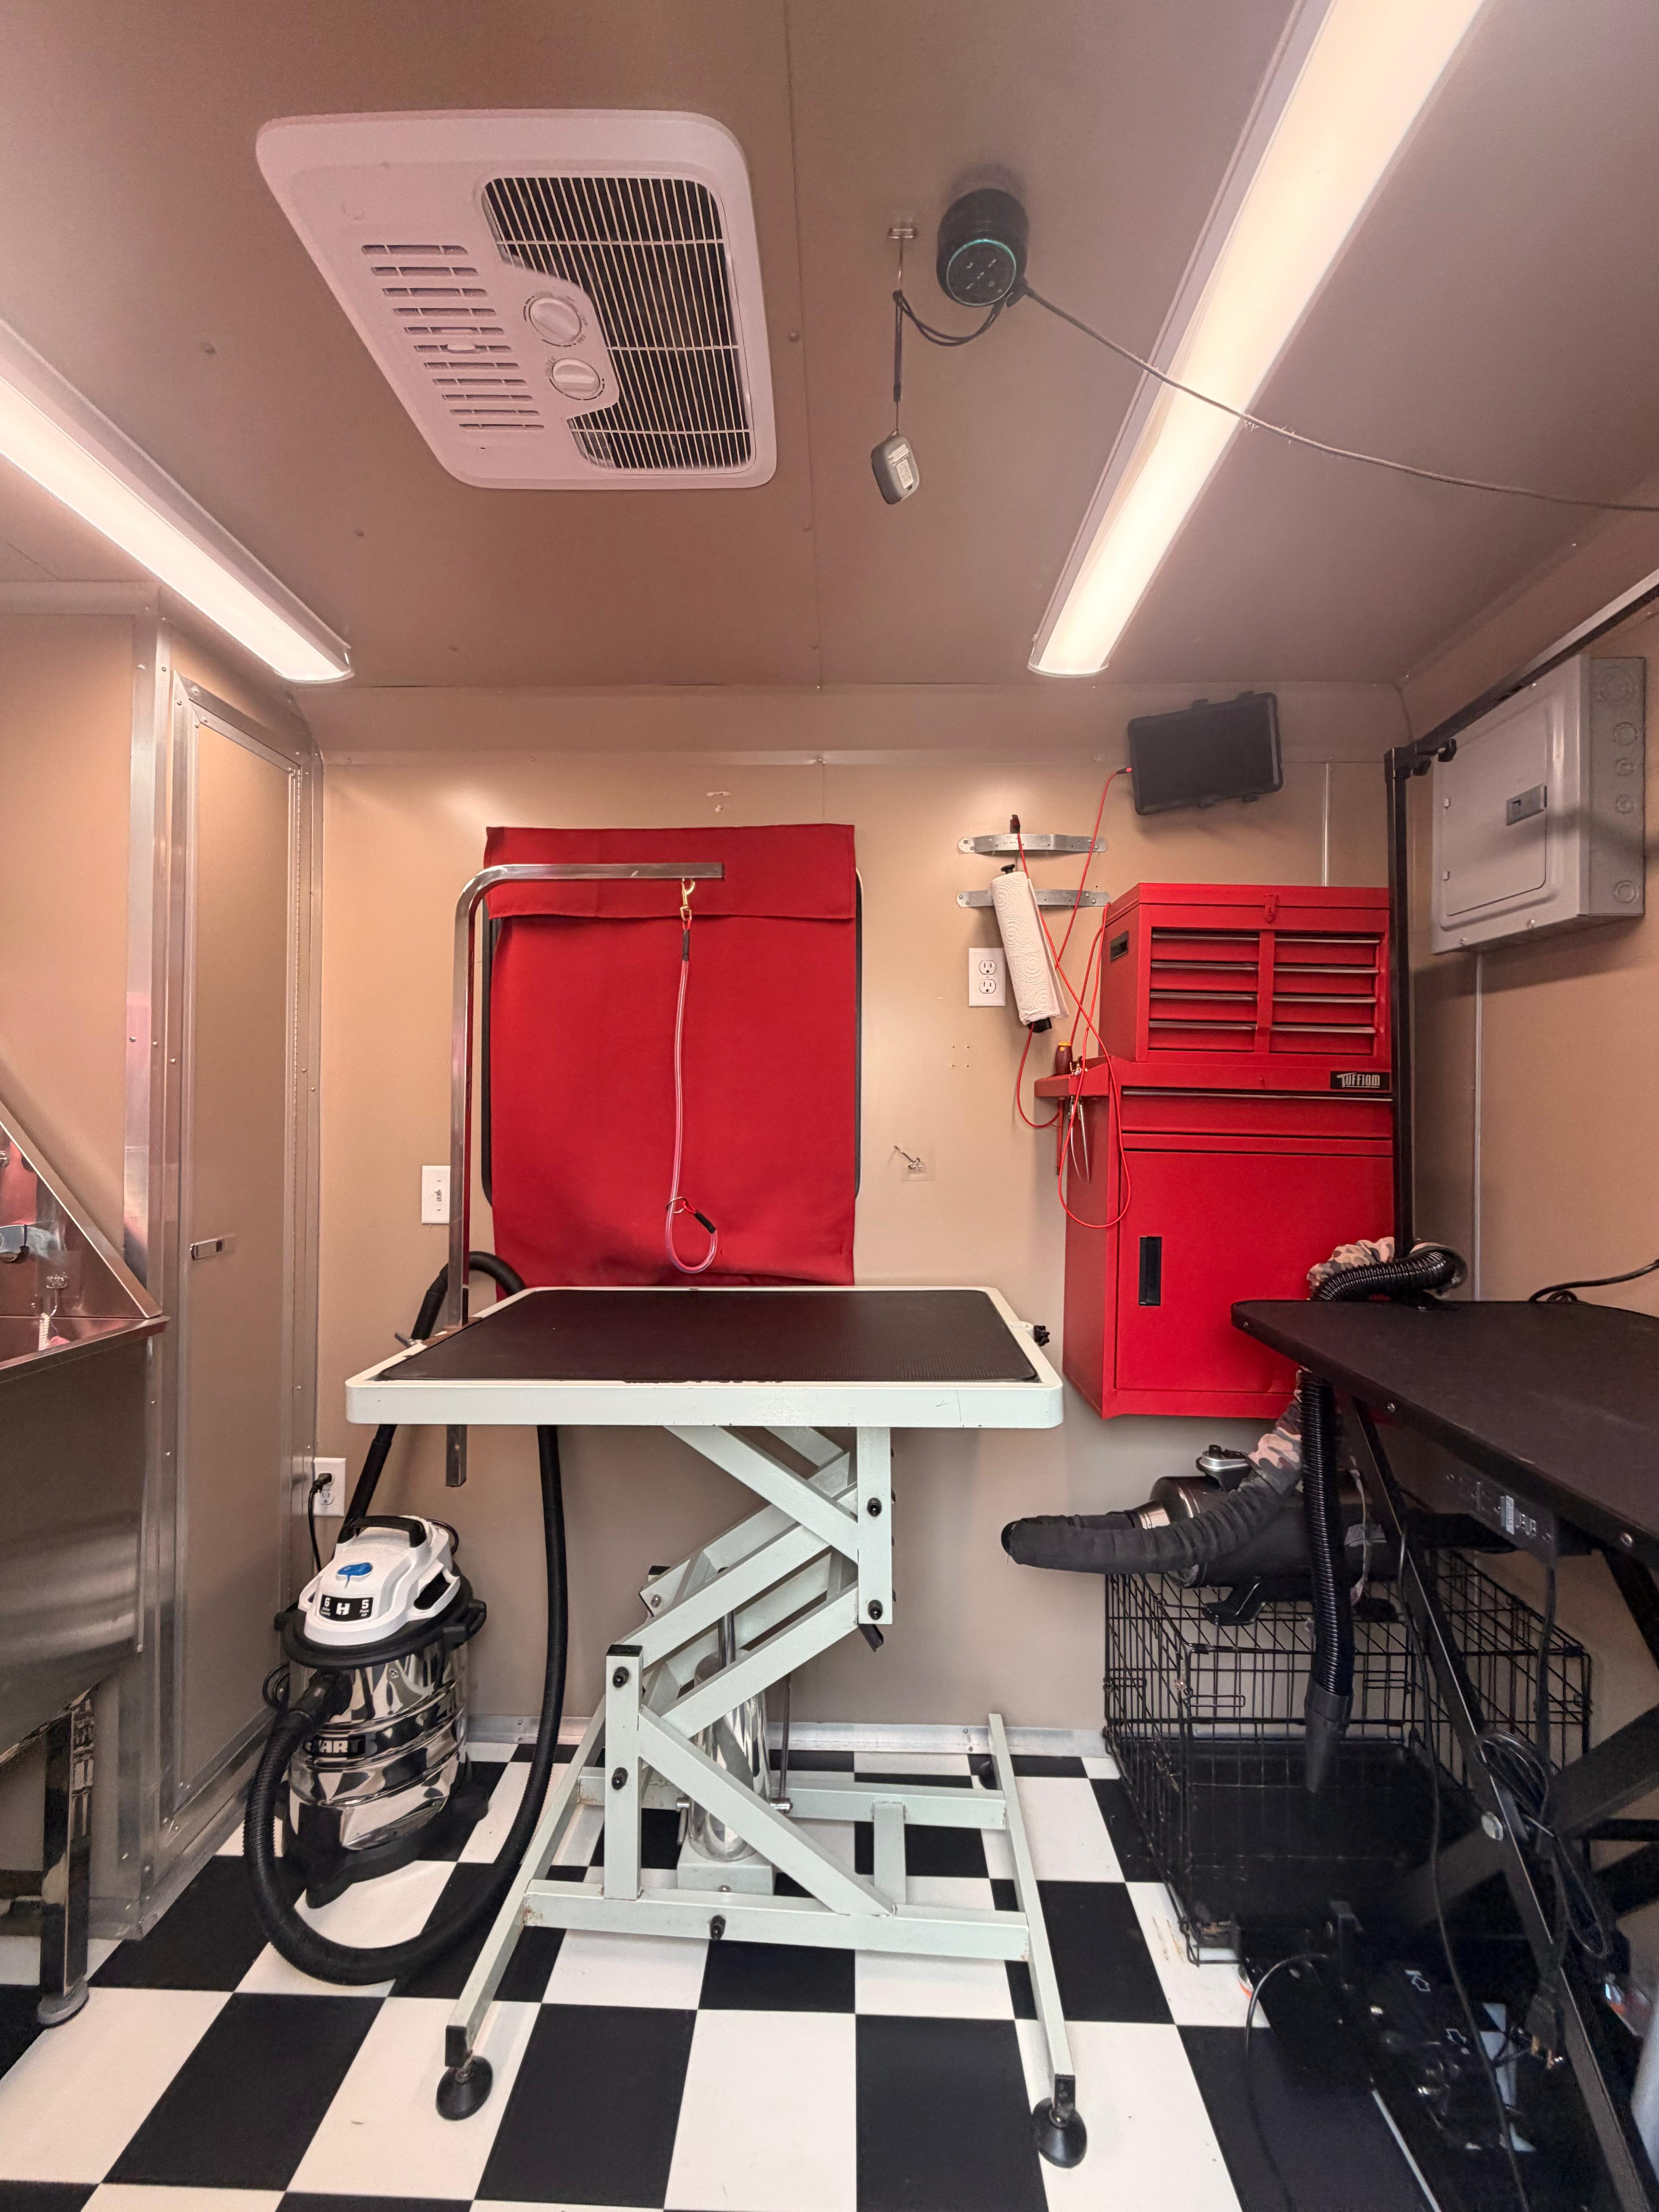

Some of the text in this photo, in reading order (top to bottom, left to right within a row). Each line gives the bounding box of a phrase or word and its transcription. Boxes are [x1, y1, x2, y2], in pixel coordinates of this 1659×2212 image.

[324, 1597, 331, 1607] 6
[362, 1599, 369, 1609] 5
[336, 1602, 350, 1615] H
